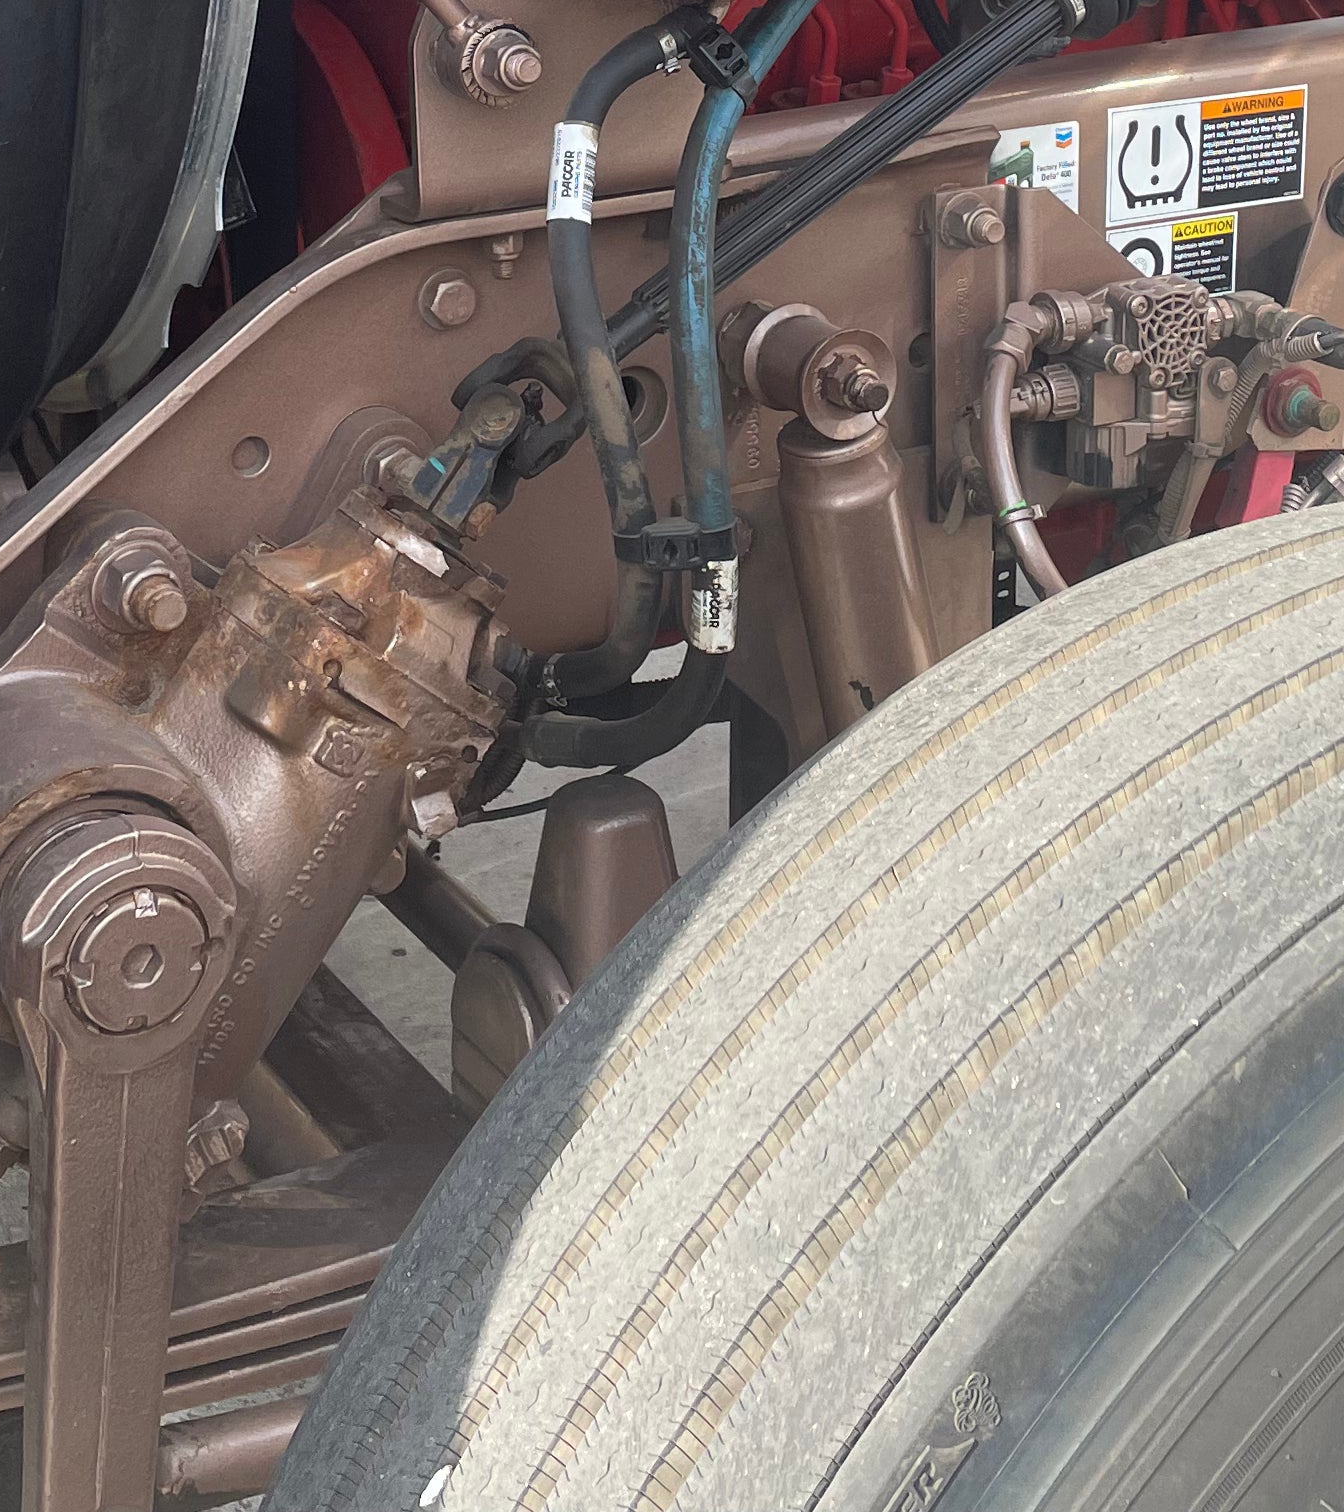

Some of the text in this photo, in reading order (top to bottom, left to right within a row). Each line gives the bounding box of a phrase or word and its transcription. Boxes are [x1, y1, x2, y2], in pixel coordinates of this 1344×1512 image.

[1232, 96, 1284, 112] WARNING
[561, 150, 575, 198] PACCAR
[1184, 220, 1233, 236] CAUTION
